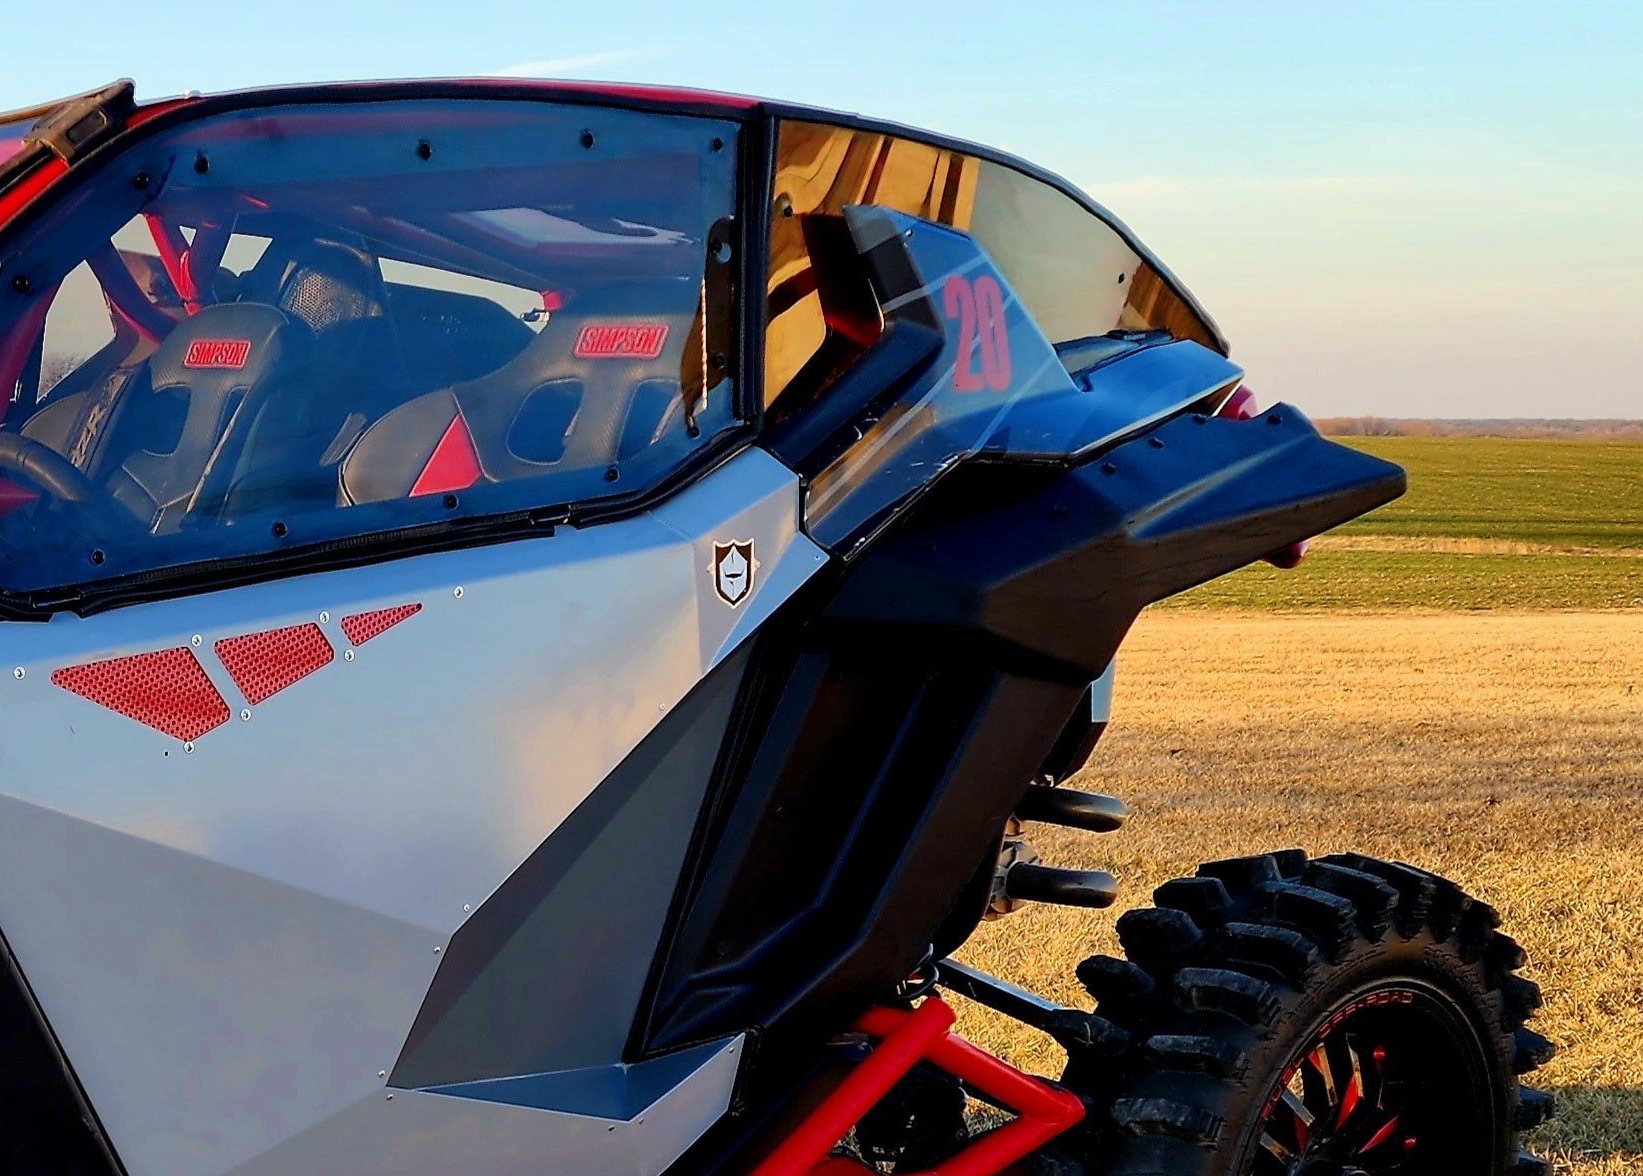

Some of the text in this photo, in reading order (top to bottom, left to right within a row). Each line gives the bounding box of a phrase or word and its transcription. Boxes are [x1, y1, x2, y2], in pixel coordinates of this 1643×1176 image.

[581, 326, 661, 353] SIMPSON
[942, 274, 1012, 392] 20
[189, 342, 247, 365] SIMPSON
[1318, 991, 1413, 1039] OFF-ROAD
